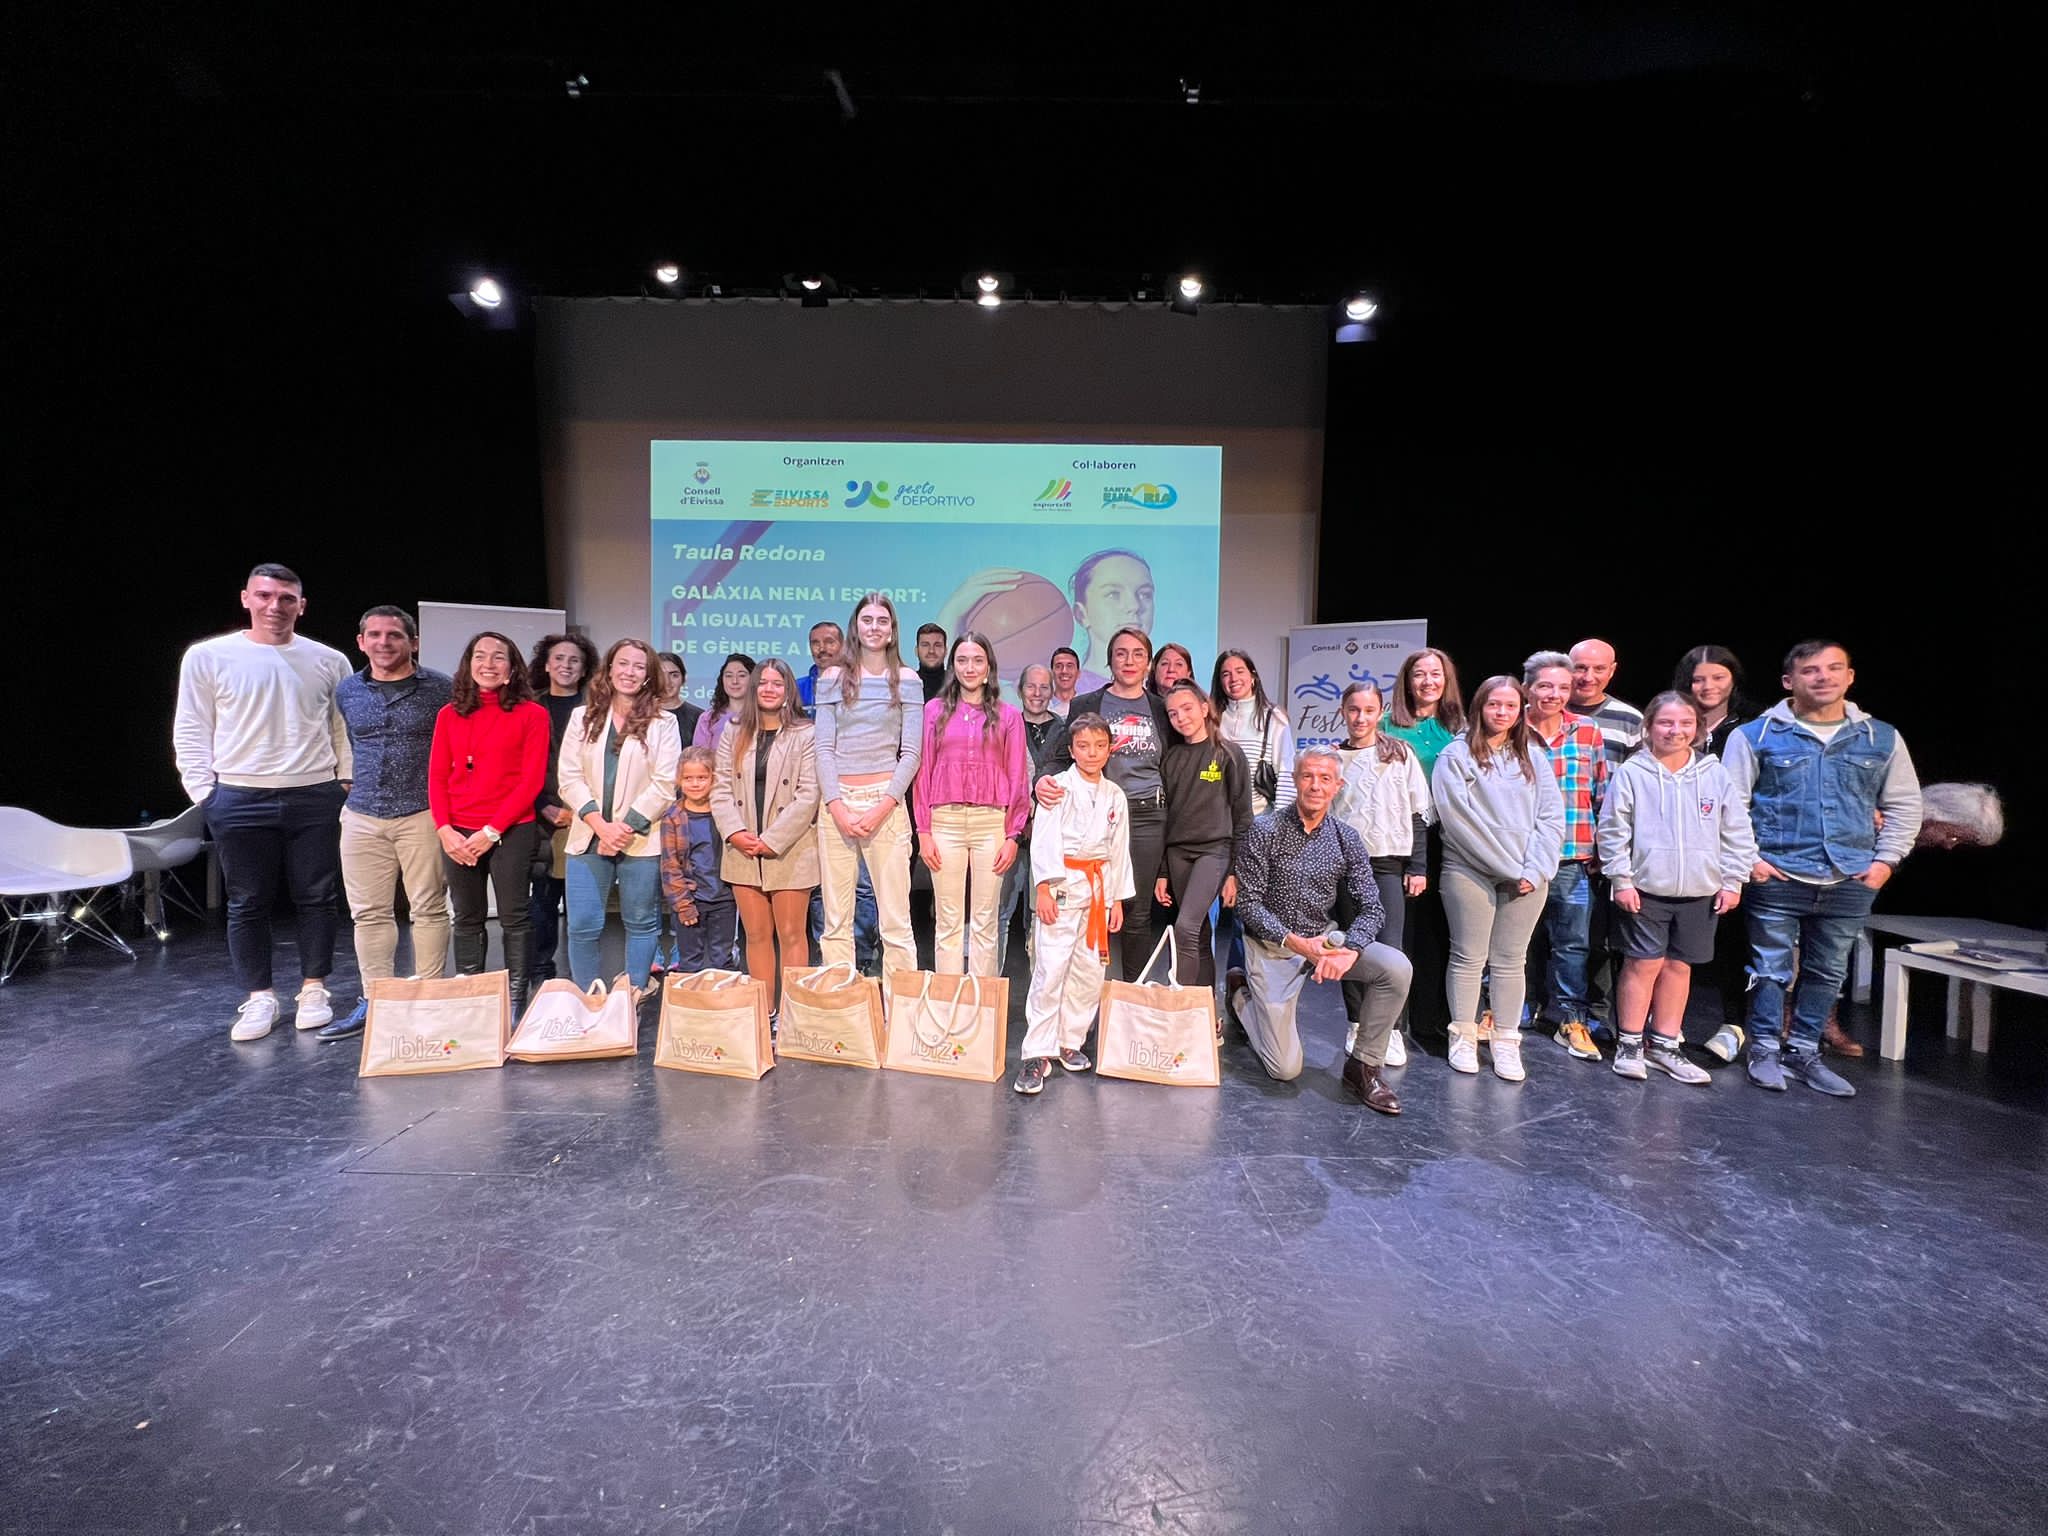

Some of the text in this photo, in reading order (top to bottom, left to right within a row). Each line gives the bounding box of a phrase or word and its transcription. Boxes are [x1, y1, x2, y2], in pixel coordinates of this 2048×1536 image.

[783, 456, 845, 468] Organitzen
[1072, 460, 1137, 470] Col·laboren
[684, 487, 721, 496] Consell
[895, 481, 935, 501] gesto
[680, 497, 724, 505] d'Eivissa
[902, 495, 975, 506] DEPORTIVO
[673, 544, 826, 561] Taula Redona
[671, 582, 763, 601] GALÀXIA
[768, 586, 825, 602] NENA
[829, 588, 835, 602] I
[671, 612, 805, 628] LA IGUALTAT
[671, 639, 697, 654] DE
[702, 636, 784, 656] GÈNERE
[787, 641, 801, 656] A
[1128, 740, 1156, 752] VIDA
